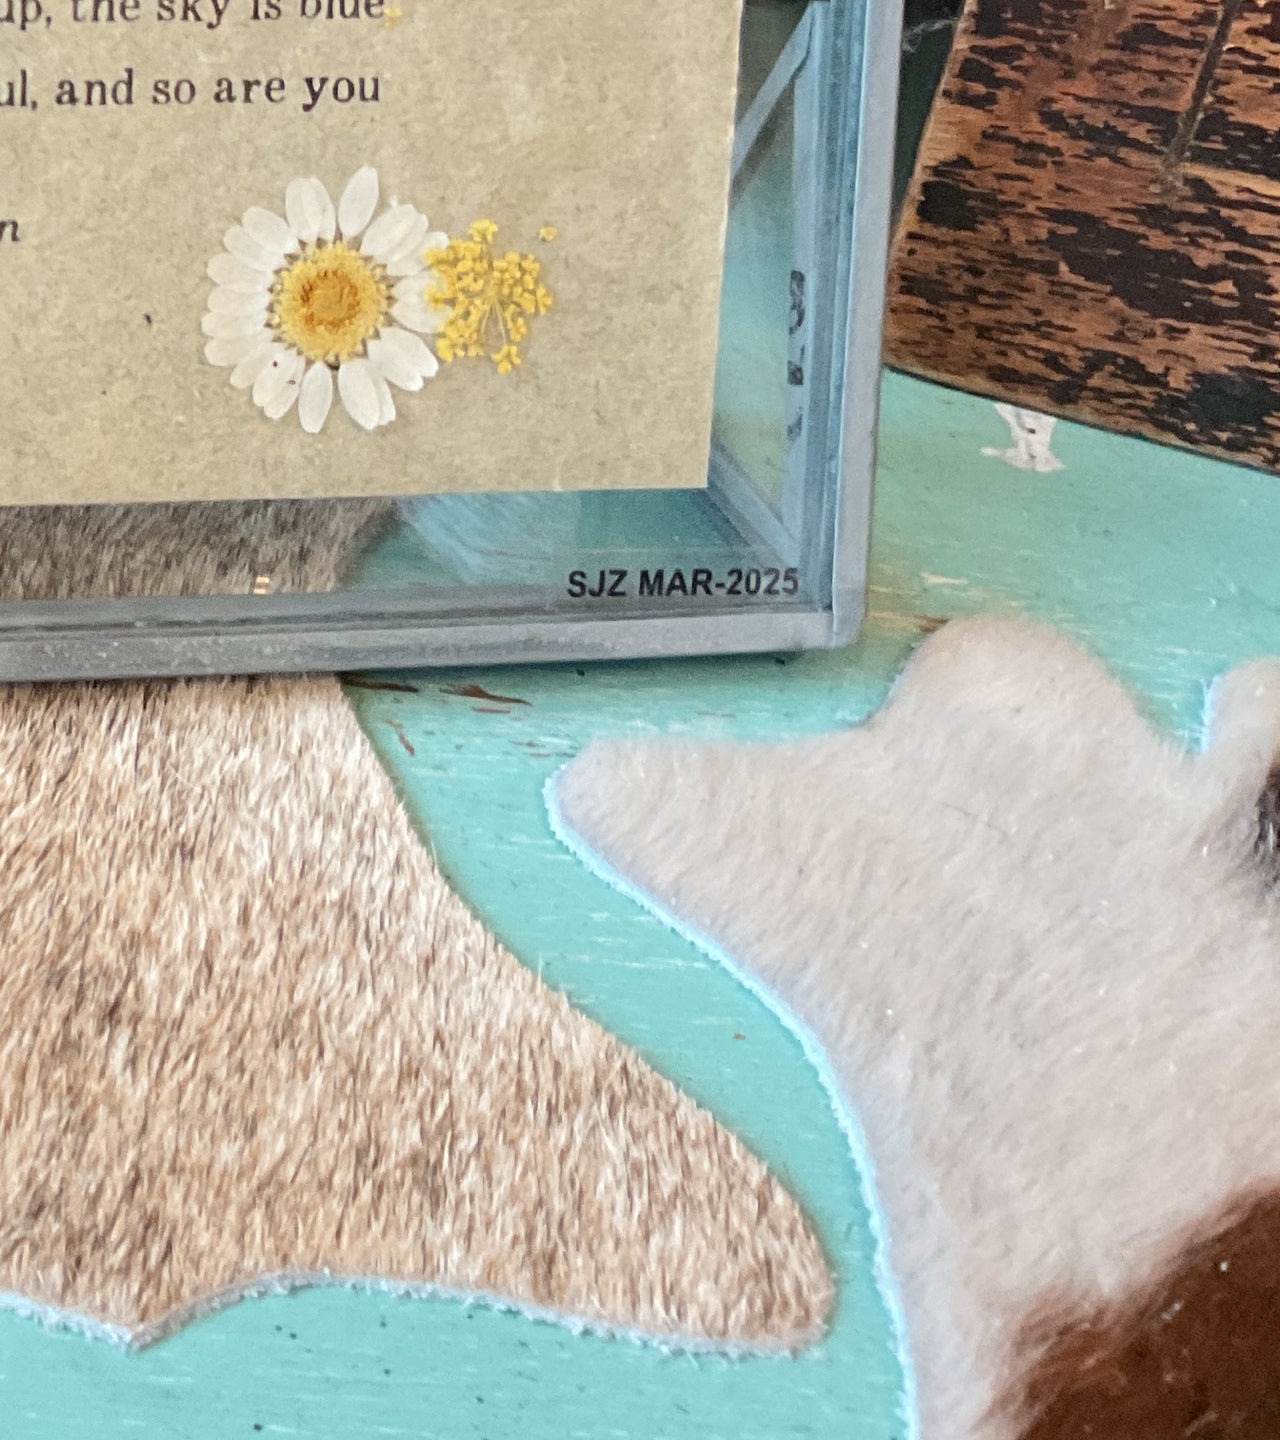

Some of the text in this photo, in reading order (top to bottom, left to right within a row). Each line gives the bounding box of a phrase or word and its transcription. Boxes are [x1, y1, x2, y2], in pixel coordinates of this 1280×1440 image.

[55, 67, 135, 106] and
[151, 78, 196, 106] so
[213, 76, 286, 105] are
[301, 75, 381, 113] you
[566, 566, 800, 598] SJZ MAR-2025
